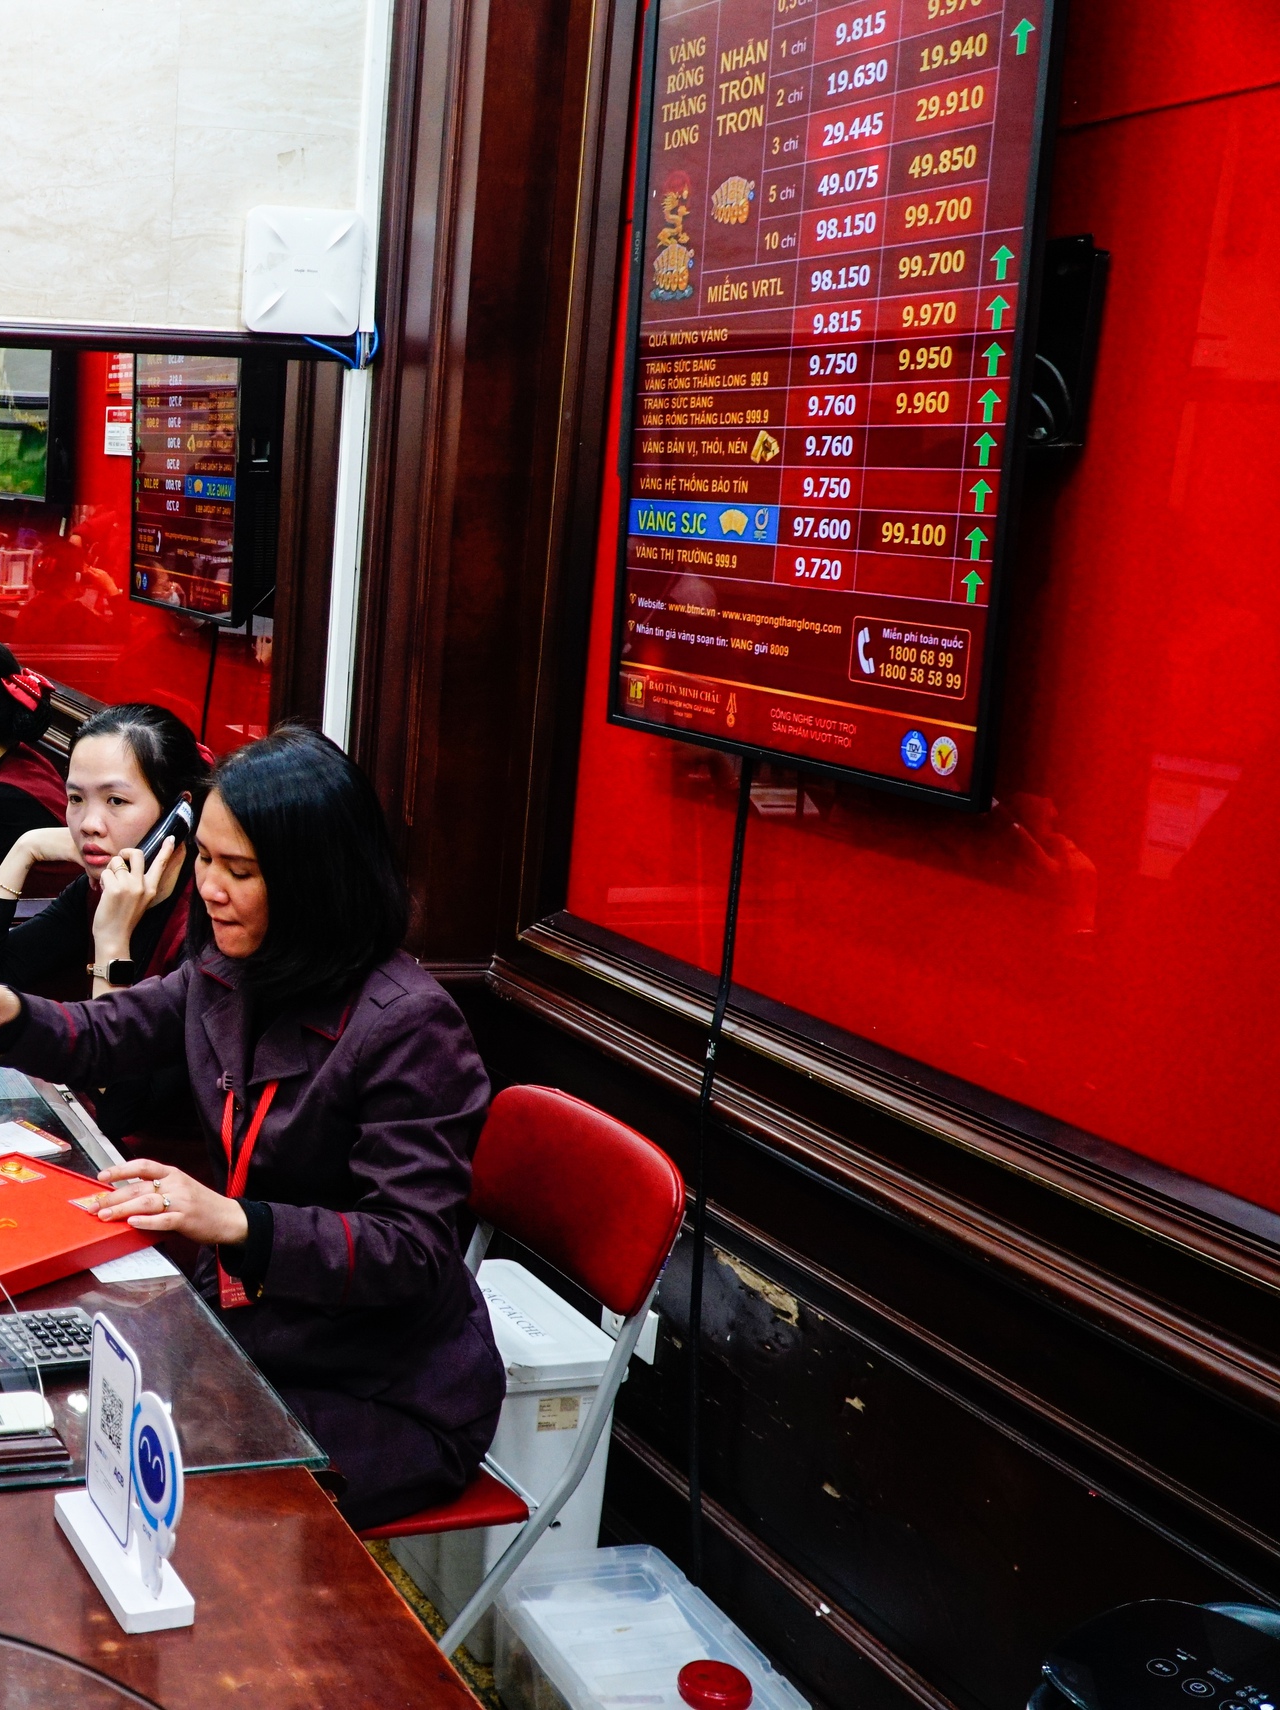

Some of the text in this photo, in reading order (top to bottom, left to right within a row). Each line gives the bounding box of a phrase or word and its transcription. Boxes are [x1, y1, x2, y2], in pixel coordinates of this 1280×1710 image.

[927, 0, 982, 20] 9.9
[669, 36, 706, 65] VÀNG
[720, 38, 768, 74] NHẪN
[780, 40, 787, 58] 1
[835, 10, 887, 46] 9.815
[919, 32, 988, 73] 19.940
[666, 63, 704, 94] RỒNG
[719, 71, 766, 105] TRÒN
[776, 89, 785, 107] 2
[826, 59, 888, 96] 19.630
[915, 85, 984, 122] 29.910
[661, 93, 707, 123] THĂNG
[716, 105, 764, 137] TRƠN
[664, 124, 700, 150] LONG
[772, 137, 780, 155] 3
[822, 111, 884, 147] 29.445
[908, 145, 977, 179] 49.850
[769, 185, 777, 203] 5
[817, 164, 879, 197] 49.075
[905, 196, 972, 229] 99.700
[765, 231, 779, 250] 10
[816, 211, 876, 242] 98.150
[707, 249, 965, 304] MIẾNG VRTL 98.150 99.700
[701, 326, 729, 343] VÀNG
[812, 309, 862, 335] 9.815
[902, 301, 957, 328] 9.970
[646, 362, 672, 375] TRANG
[674, 358, 691, 373] SỨC
[809, 352, 858, 376] 9.750
[898, 346, 953, 371] 9.950
[722, 374, 747, 387] LONG
[750, 371, 769, 387] 99.9
[644, 398, 670, 410] TRANG
[671, 394, 688, 409] SỨC
[808, 394, 856, 417] 9.760
[896, 391, 950, 414] 9.960
[720, 412, 744, 425] LONG
[745, 409, 769, 424] 999.9
[642, 437, 665, 454] VÀNG
[728, 437, 748, 454] NÉN
[805, 435, 853, 457] 9.760
[640, 474, 662, 490] VÀNG
[664, 475, 677, 494] HỆ
[679, 472, 709, 492] THỐNG
[732, 476, 749, 494] TÍN
[803, 476, 851, 498] 9.750
[637, 504, 946, 546] VÀNG SJC 97.600 99.100
[635, 543, 842, 581] VÀNG THỊ TRƯỜNG 999.9 9.720
[637, 597, 842, 634] Website: www.btmc.vn www.vangrongthanglong.com
[655, 626, 664, 637] tin
[696, 634, 715, 646] soạn
[730, 637, 753, 651] VANG
[770, 643, 789, 657] 8009
[903, 631, 918, 643] phí
[919, 633, 939, 645] toàn
[940, 635, 964, 649] quốc
[889, 645, 954, 668] 1800 68 99
[665, 681, 677, 694] TÍN
[679, 686, 699, 700] MINH
[879, 662, 961, 690] 1800 58 58 99
[770, 707, 791, 721] CÔNG
